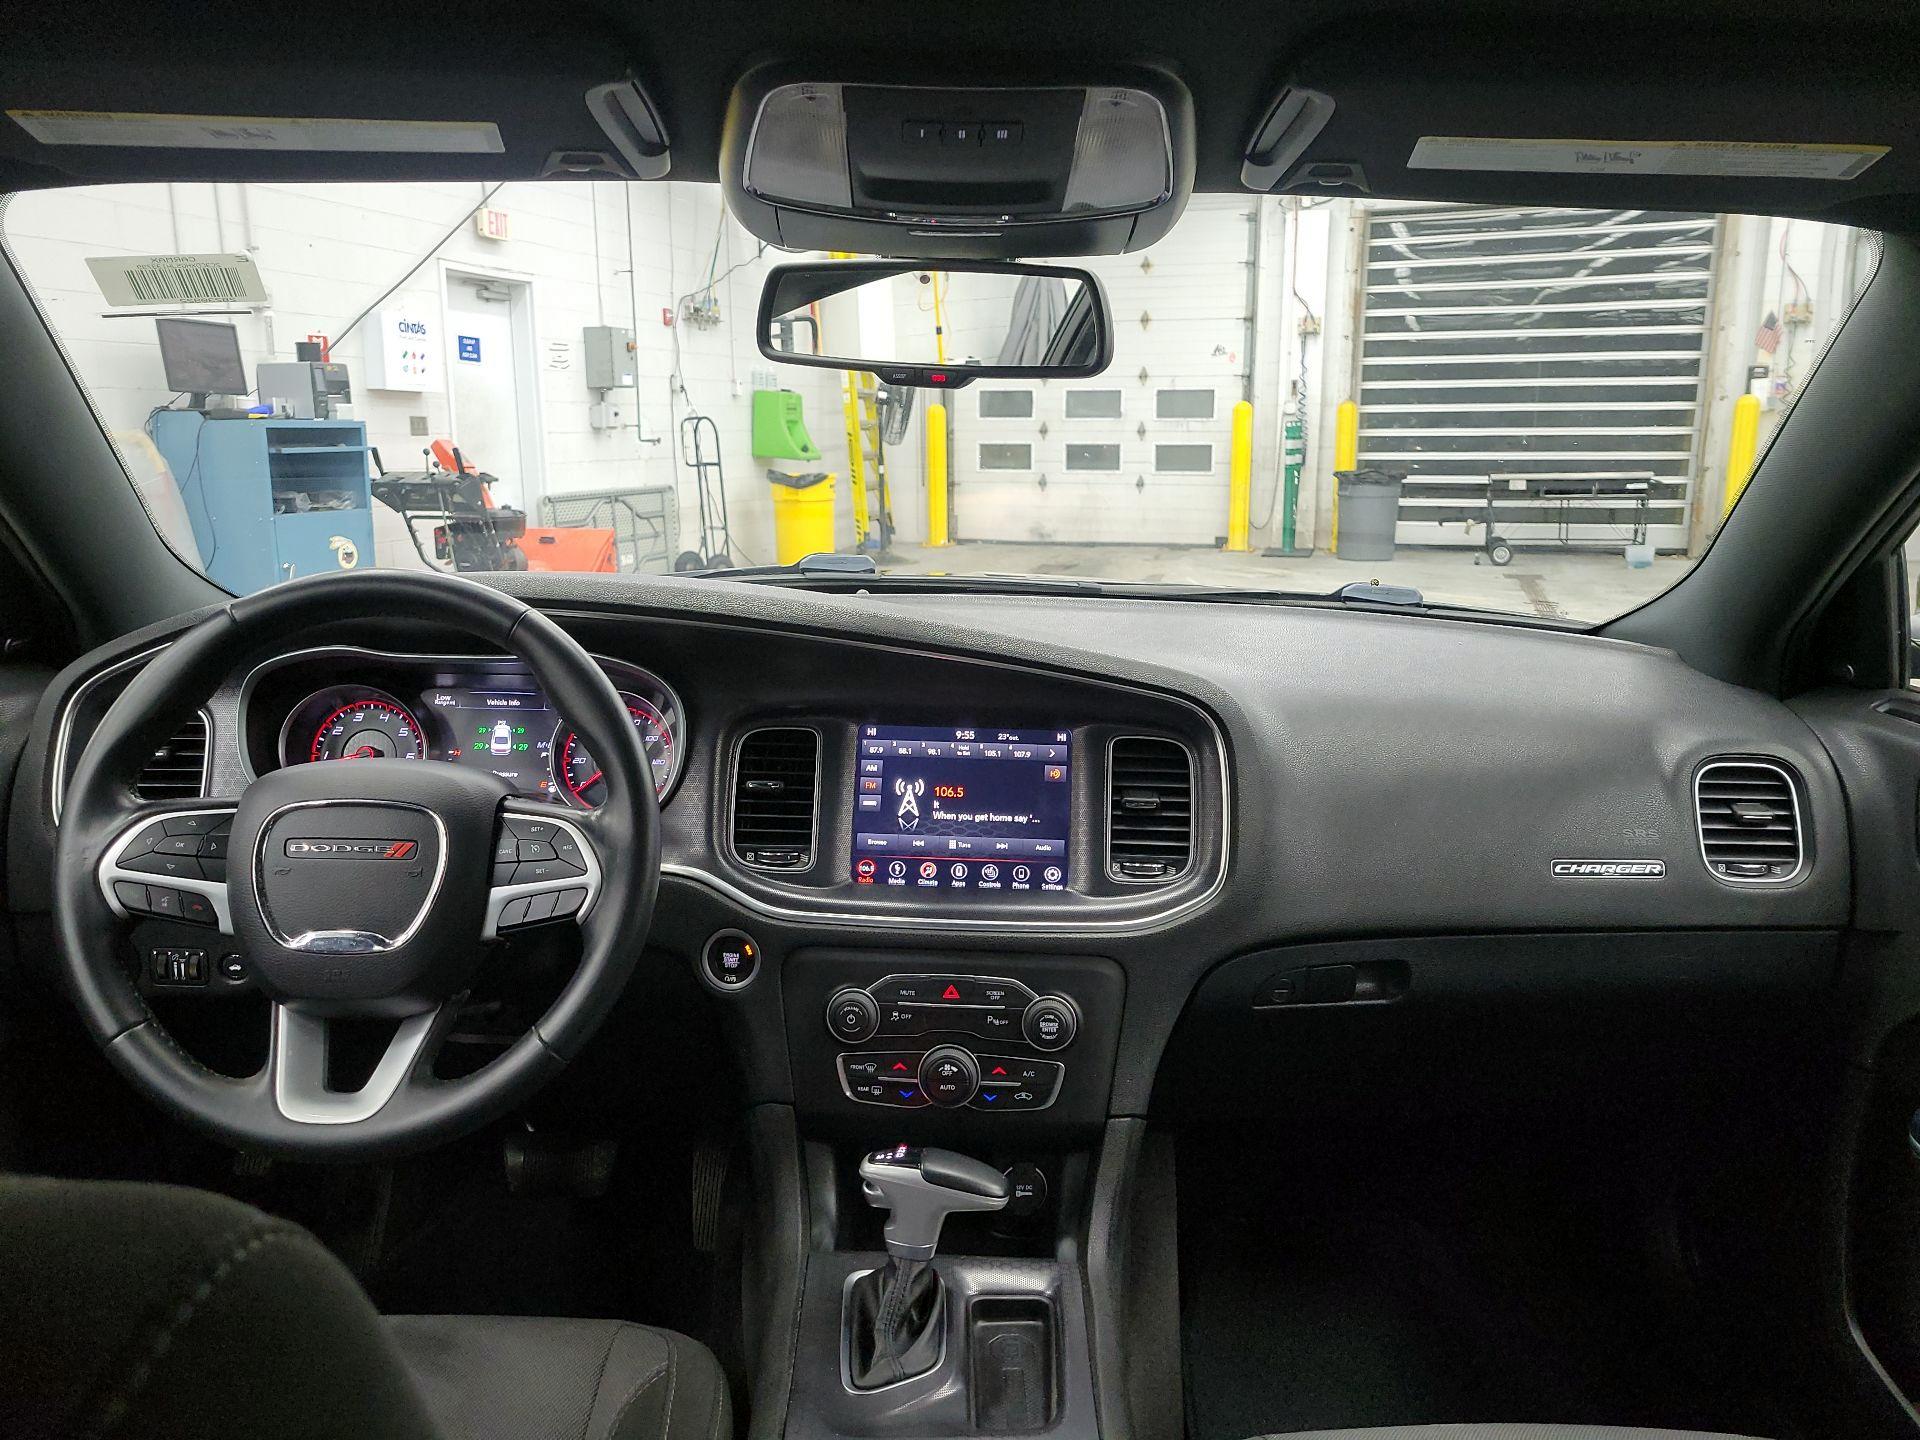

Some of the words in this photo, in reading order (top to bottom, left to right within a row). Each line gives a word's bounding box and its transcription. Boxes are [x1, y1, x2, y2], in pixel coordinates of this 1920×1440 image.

[487, 210, 509, 239] EXIT
[436, 693, 452, 701] Low
[352, 712, 365, 722] 3
[379, 713, 390, 723] 4
[332, 727, 344, 736] 2
[397, 727, 409, 737] 5
[866, 727, 877, 737] HI
[955, 730, 975, 740] 9:55
[1056, 733, 1067, 742] HI
[472, 742, 484, 751] 29
[518, 743, 529, 751] 29
[1013, 750, 1032, 758] 107.9
[865, 764, 878, 772] AM
[934, 786, 964, 797] 106.5
[932, 811, 957, 820] When
[957, 813, 973, 822] you
[974, 813, 989, 823] get
[989, 813, 1013, 822] home
[1013, 816, 1028, 824] say
[289, 843, 396, 854] DODGE
[1035, 844, 1052, 852] Audio
[1554, 863, 1663, 875] CHARGER
[857, 876, 874, 884] Radio
[888, 877, 905, 885] Media
[917, 878, 939, 887] Climate
[951, 879, 966, 888] Apps
[978, 881, 1002, 889] Controls
[1012, 882, 1030, 890] Phone
[1041, 883, 1064, 891] Settings
[1022, 1070, 1036, 1078] A/C
